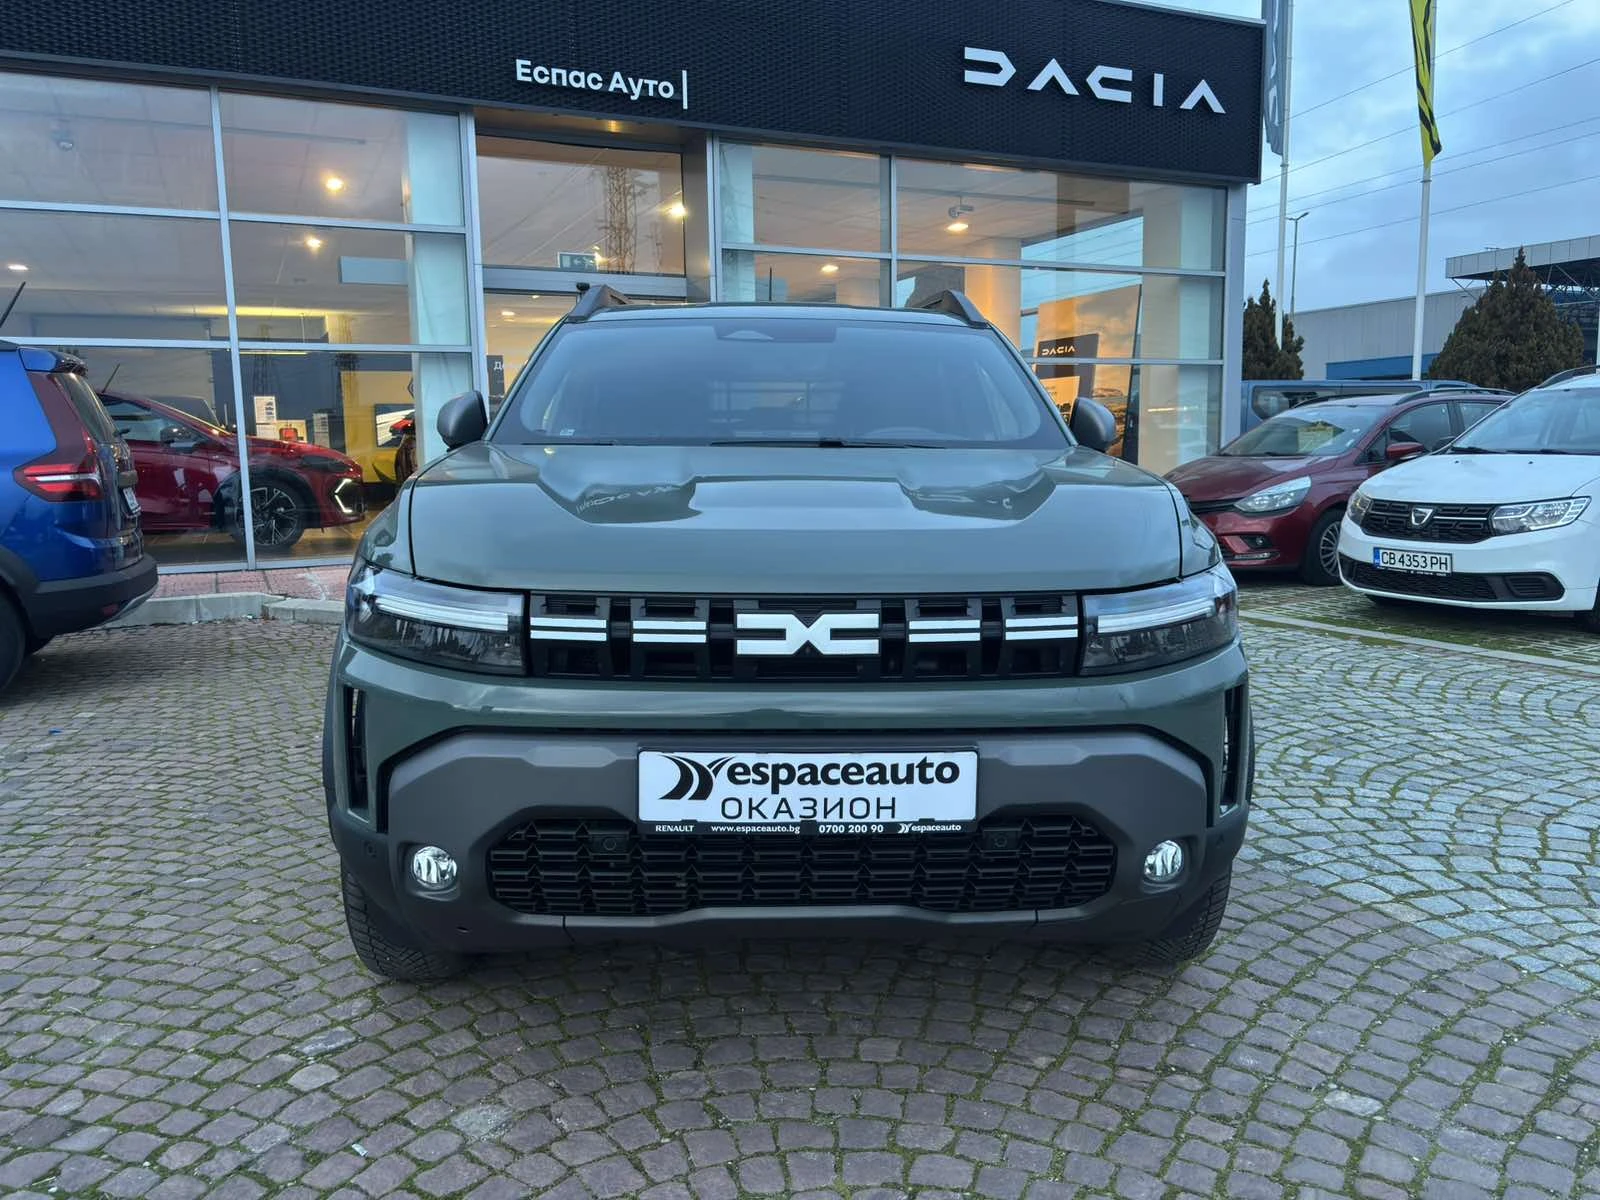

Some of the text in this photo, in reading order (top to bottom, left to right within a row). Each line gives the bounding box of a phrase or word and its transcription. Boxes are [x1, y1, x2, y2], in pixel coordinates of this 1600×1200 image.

[515, 58, 674, 101] Еспас Ауто
[964, 46, 1226, 114] DACIA
[1041, 345, 1076, 356] DACIA
[1398, 554, 1428, 569] 4353
[726, 756, 960, 795] espaceauto
[720, 796, 896, 820] ОКАЗИОН
[655, 823, 962, 835] RENAULT www.espaceauto.bg 0700 200 90 espaceauto
